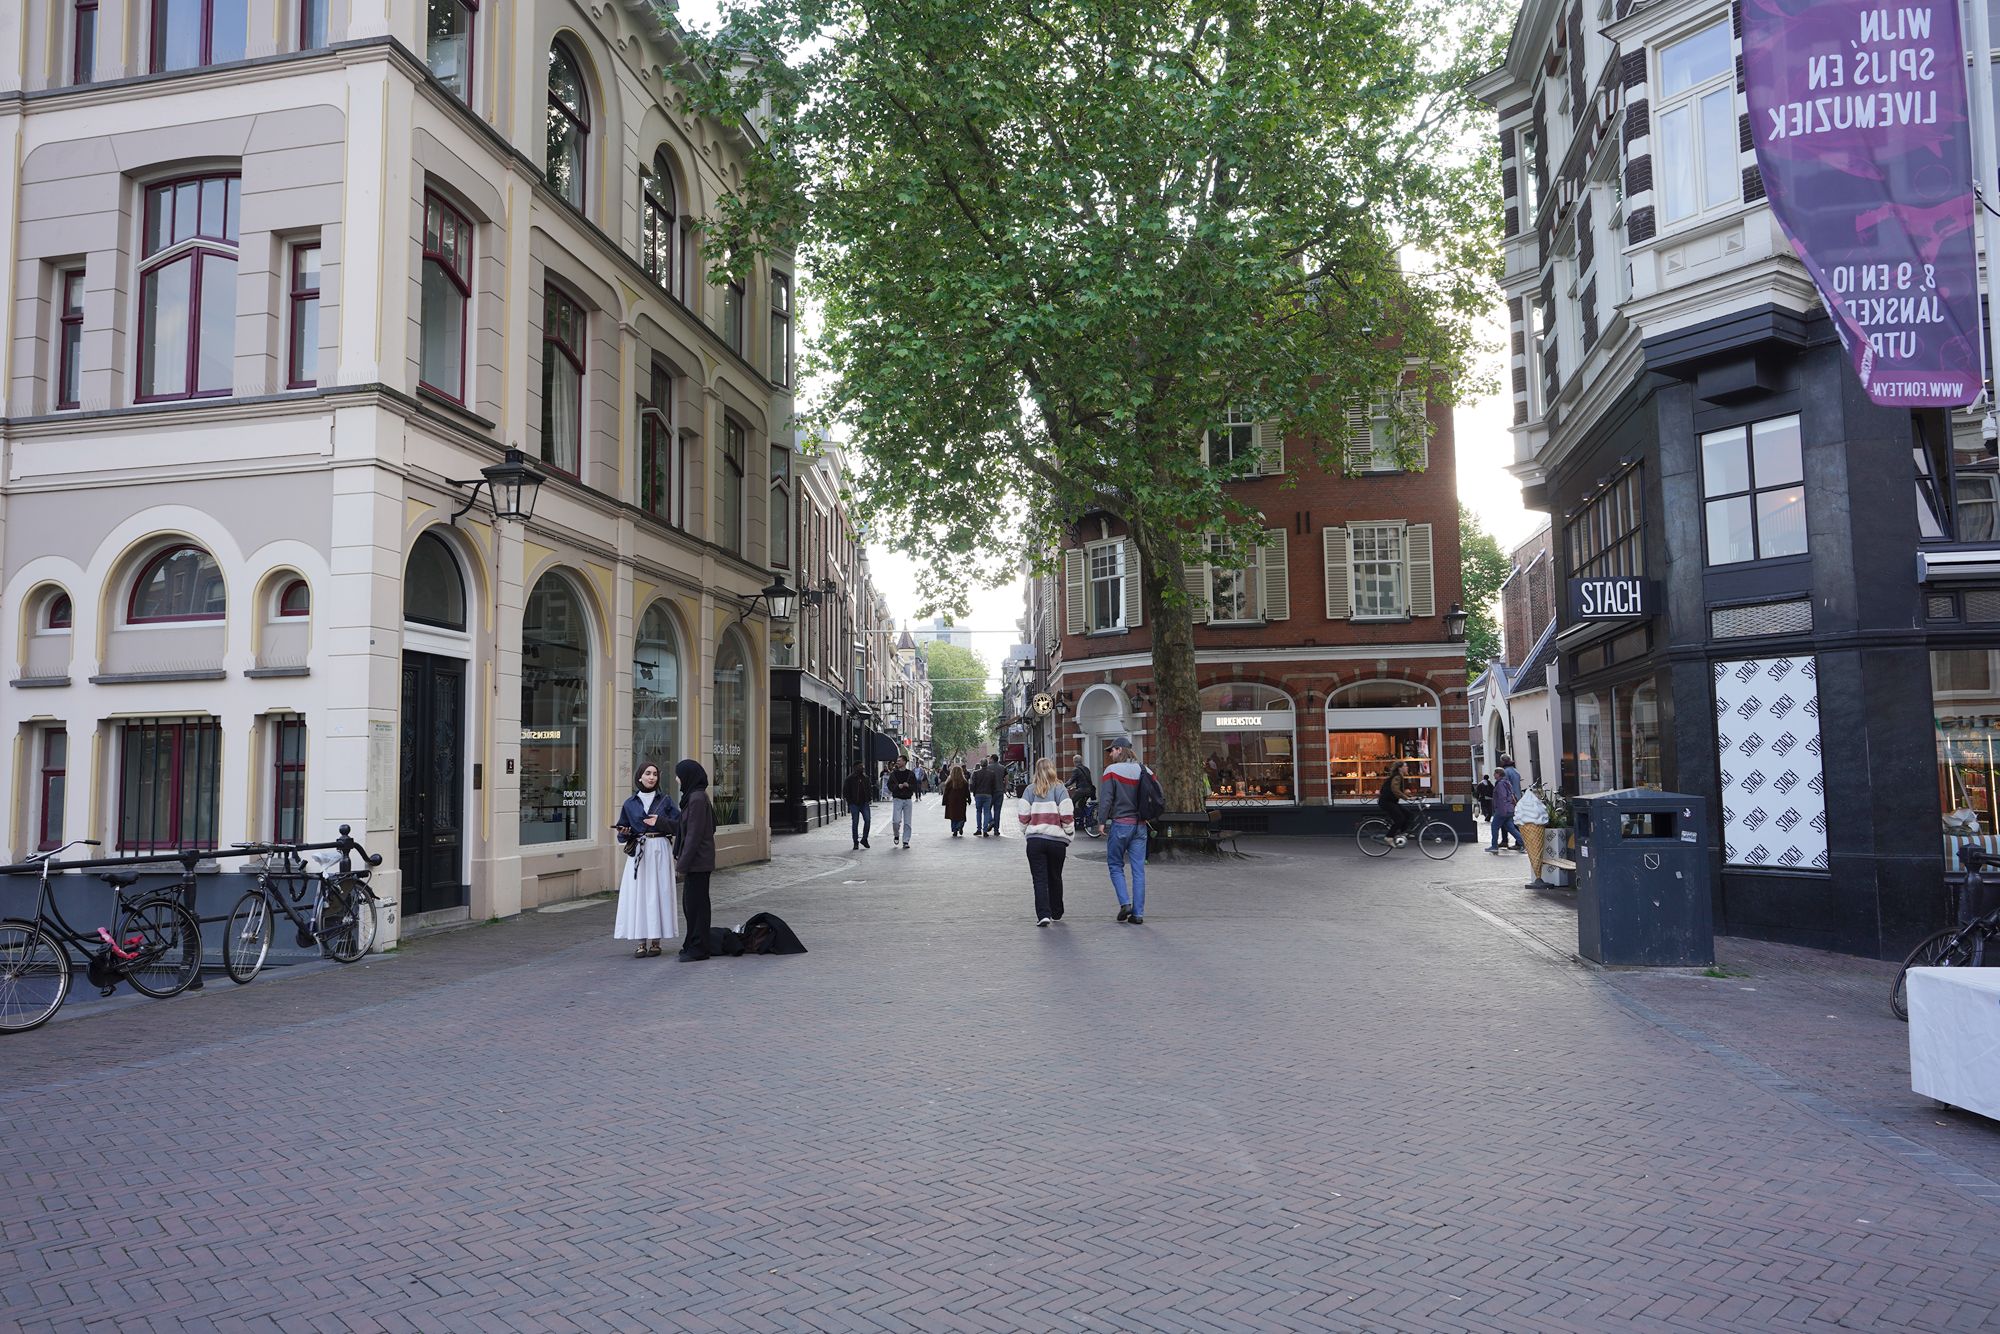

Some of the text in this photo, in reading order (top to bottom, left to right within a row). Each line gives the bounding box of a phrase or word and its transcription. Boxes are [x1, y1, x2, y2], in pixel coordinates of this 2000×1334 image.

[1581, 580, 1642, 615] STACH
[1735, 660, 1760, 684] STACH
[1767, 657, 1794, 682] STACH
[1737, 695, 1762, 720] STACH
[1769, 693, 1796, 719] STACH
[1216, 716, 1262, 726] BIRKENSTOCK
[729, 744, 741, 756] tate
[1739, 732, 1765, 757] STACH
[1772, 731, 1799, 757] STACH
[563, 790, 586, 798] FOR YOUR
[1741, 769, 1767, 794] STACH
[1773, 769, 1800, 795] STACH
[562, 799, 587, 807] EYES ONLY
[1743, 806, 1769, 831] STACH
[1775, 807, 1802, 833] STACH
[1744, 843, 1770, 865] STACH
[1777, 845, 1804, 867] STACH
